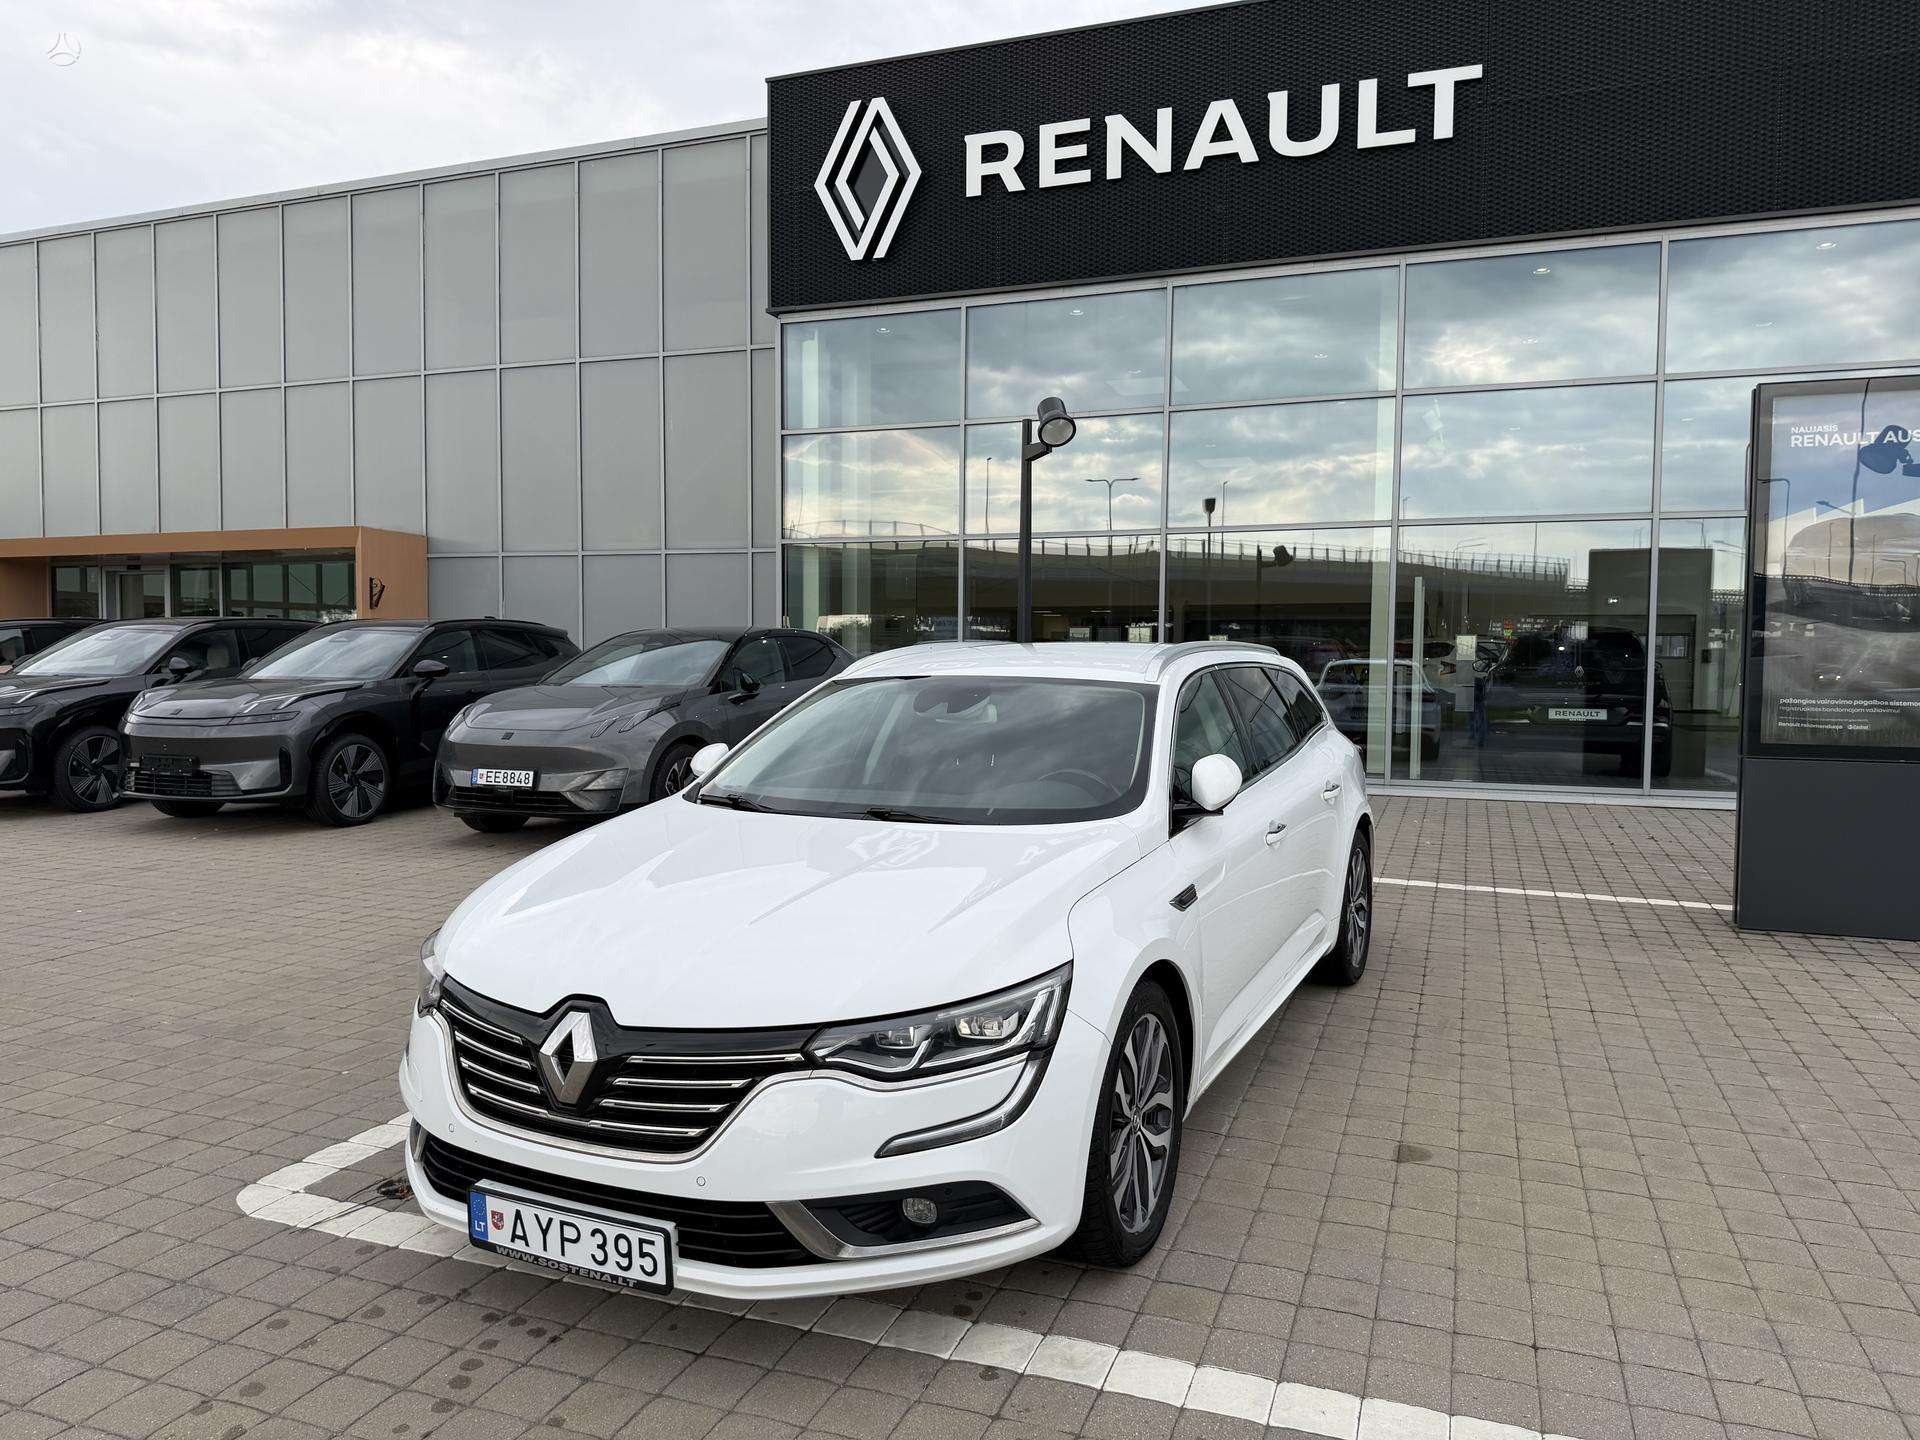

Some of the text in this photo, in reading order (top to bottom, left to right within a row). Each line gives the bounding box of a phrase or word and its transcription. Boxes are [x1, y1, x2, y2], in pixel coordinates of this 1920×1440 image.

[964, 64, 1483, 198] RENAULT
[1791, 424, 1838, 434] NAUJASIS
[1791, 431, 1880, 448] RENAULT
[1555, 710, 1600, 718] RENAULT
[485, 770, 531, 785] EE8848
[474, 1219, 486, 1233] LT
[496, 1246, 638, 1288] WWW.SOSTENA.LT
